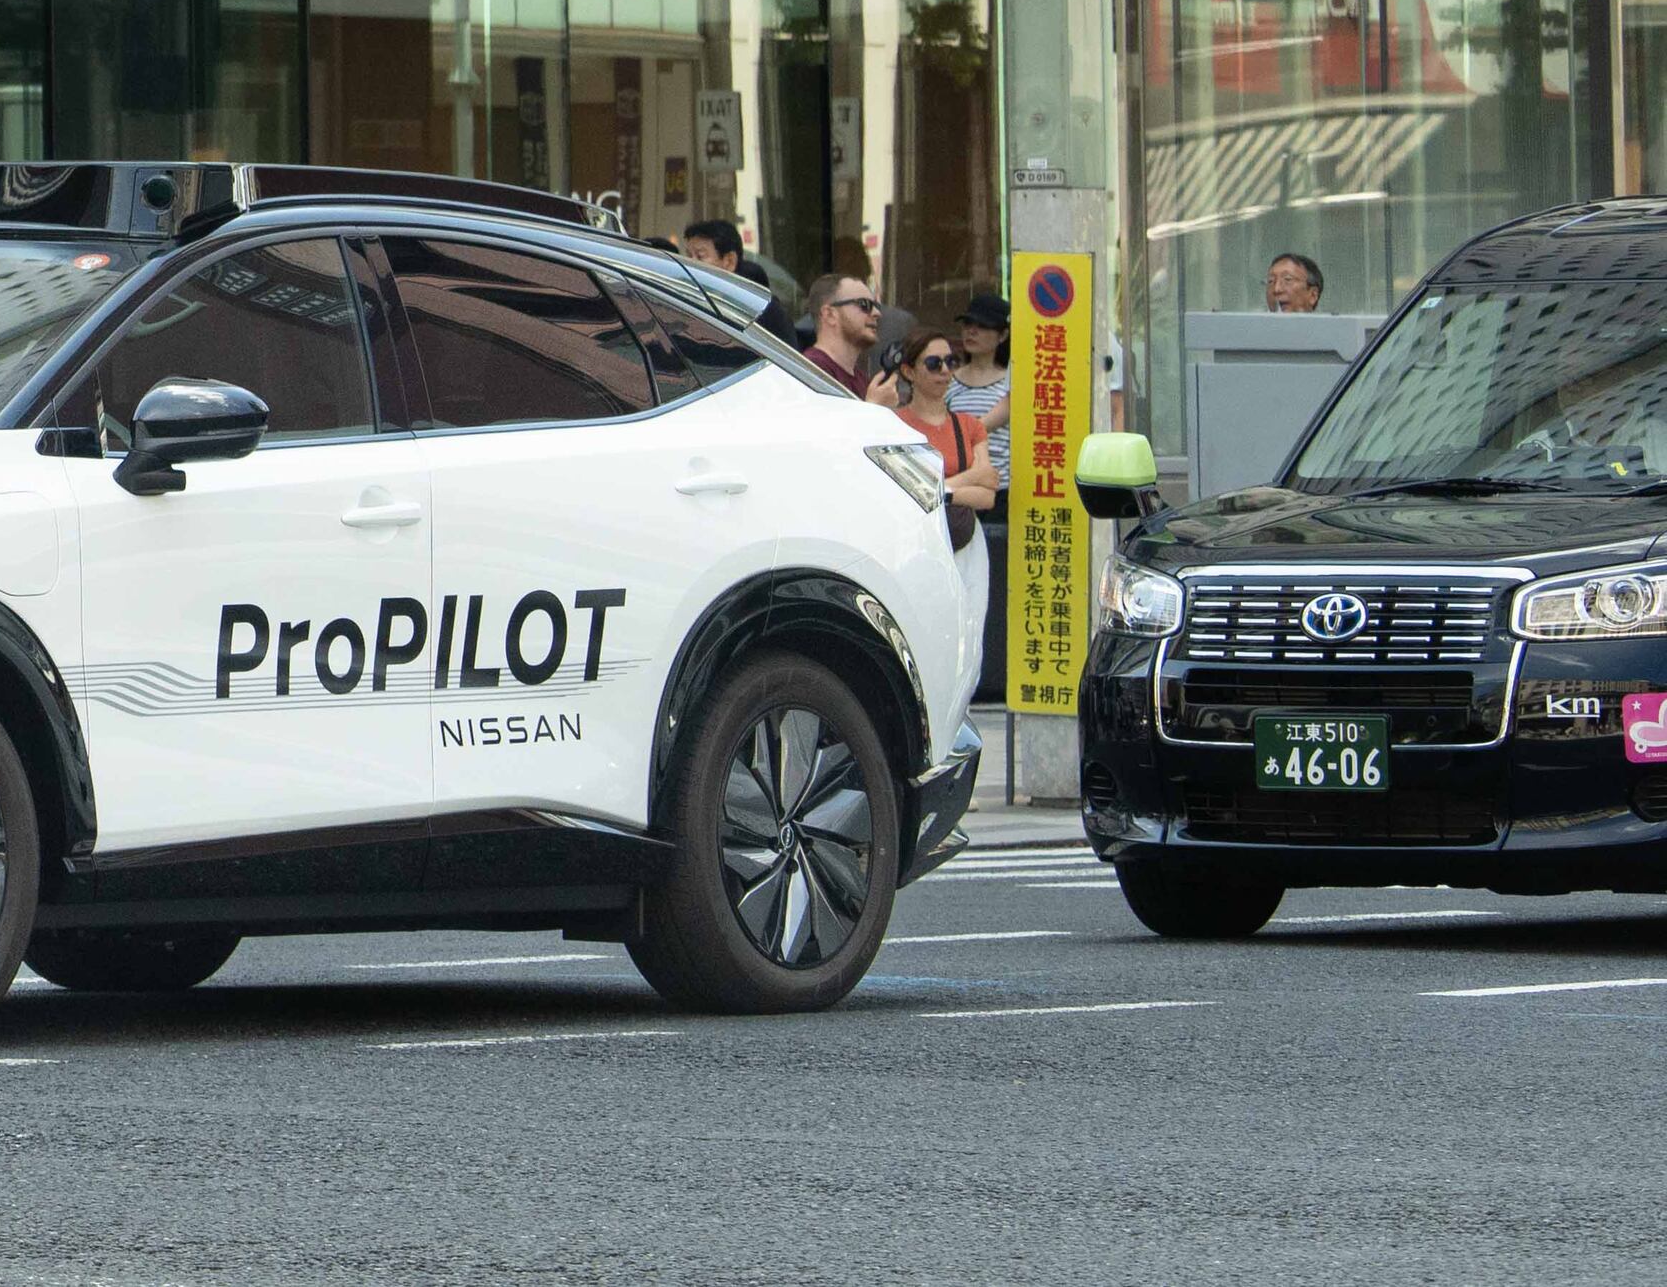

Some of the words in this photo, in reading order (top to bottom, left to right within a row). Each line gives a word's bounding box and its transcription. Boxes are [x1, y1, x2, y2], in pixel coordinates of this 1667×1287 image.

[1033, 324, 1067, 499] 違法駐車禁止
[1024, 507, 1046, 675] も取締りを行います
[1049, 508, 1072, 676] 運転者等が乗車中で
[216, 587, 627, 700] ProPILOT
[439, 713, 583, 748] NISSAN
[1020, 684, 1074, 705] 警視庁
[1546, 693, 1601, 716] km
[1264, 755, 1280, 776] あ
[1285, 747, 1381, 786] 46-06
